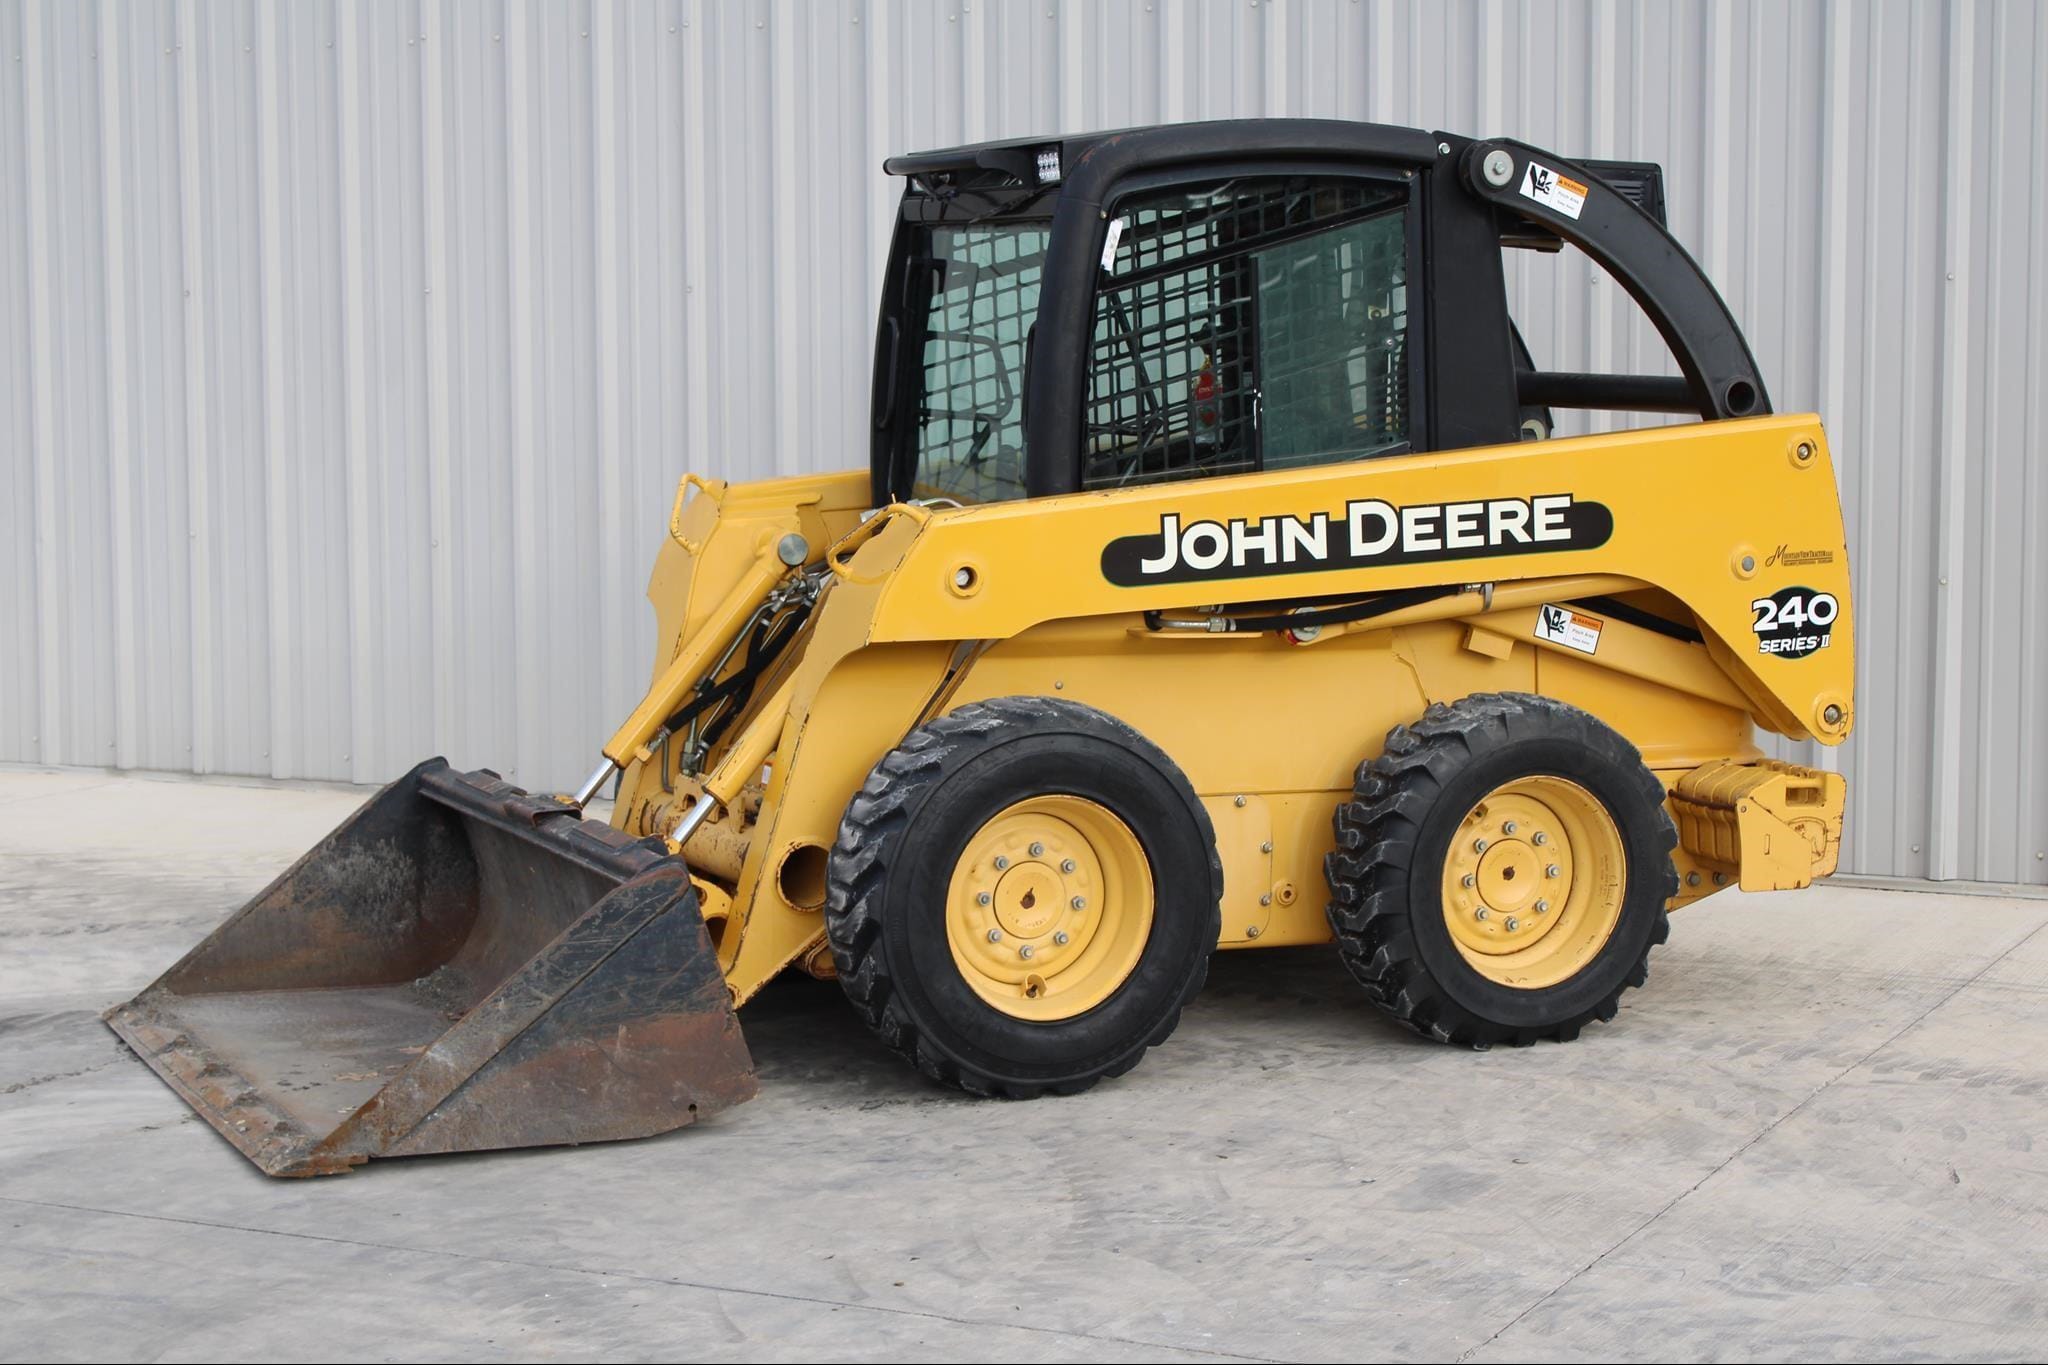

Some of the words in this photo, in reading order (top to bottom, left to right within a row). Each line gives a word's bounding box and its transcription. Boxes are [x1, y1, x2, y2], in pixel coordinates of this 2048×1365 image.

[1142, 516, 1327, 573] JOHN
[1350, 497, 1570, 556] DEERE
[1754, 595, 1837, 631] 240
[1760, 636, 1817, 652] SERIES
[1821, 635, 1830, 647] II
